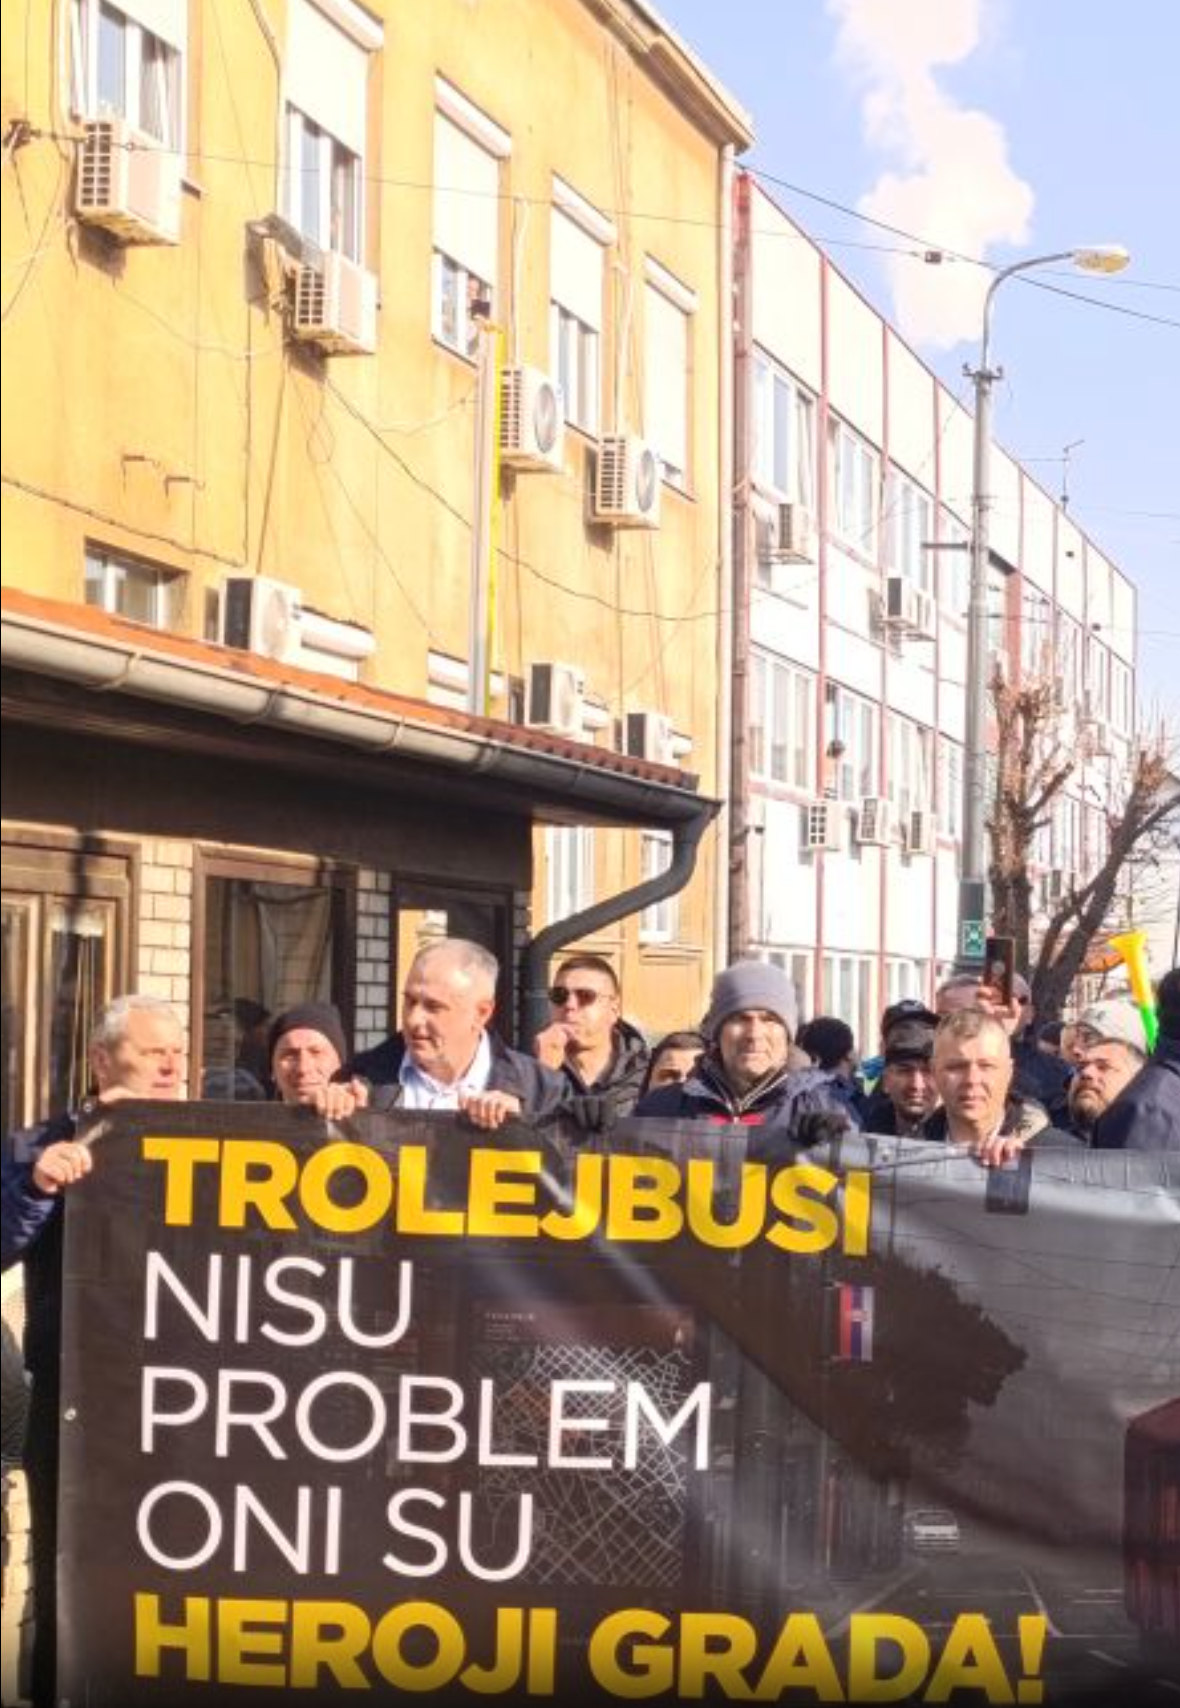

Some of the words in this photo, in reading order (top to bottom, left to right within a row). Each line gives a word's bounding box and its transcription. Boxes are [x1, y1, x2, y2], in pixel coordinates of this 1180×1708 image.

[142, 1137, 870, 1256] TROLEJBUSI
[143, 1251, 413, 1348] NISU
[140, 1365, 712, 1471] PROBLEM
[136, 1480, 342, 1575] ONI
[382, 1487, 534, 1582] SU
[133, 1592, 558, 1696] HEROJI
[588, 1607, 1048, 1706] GRADA!
